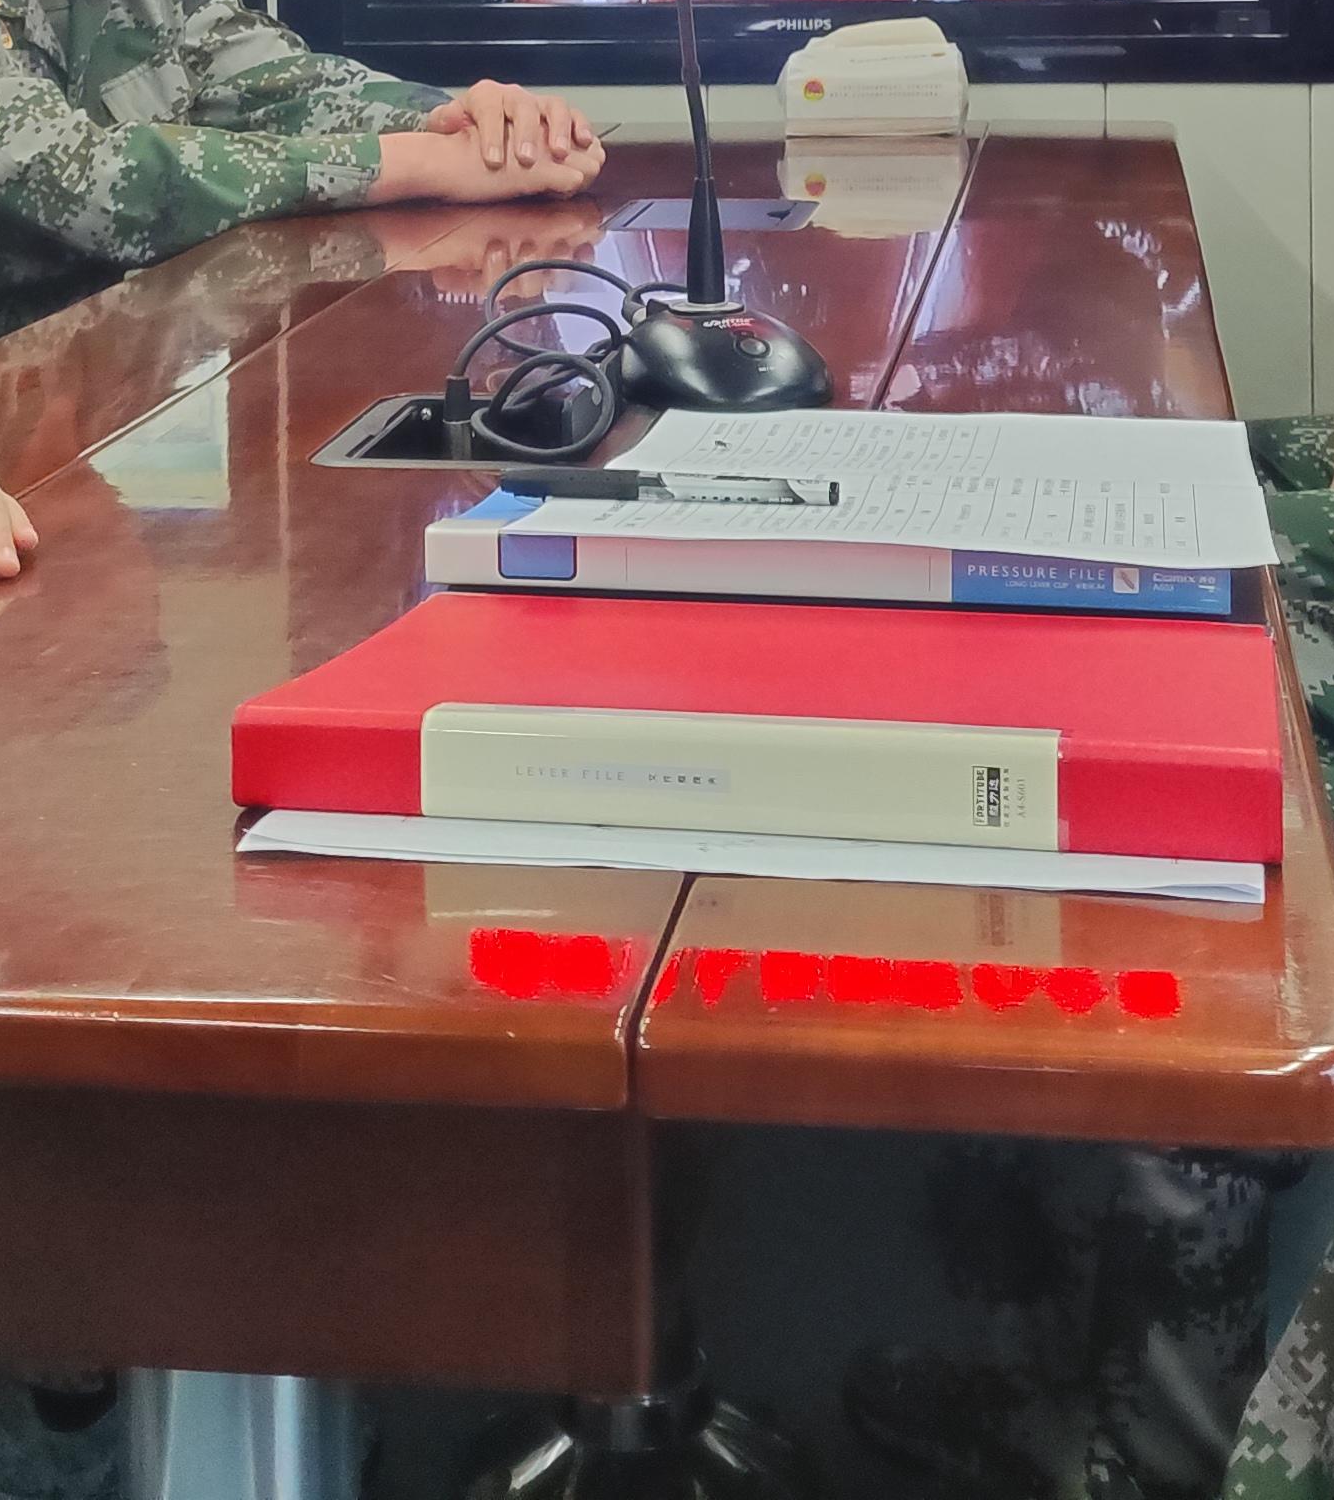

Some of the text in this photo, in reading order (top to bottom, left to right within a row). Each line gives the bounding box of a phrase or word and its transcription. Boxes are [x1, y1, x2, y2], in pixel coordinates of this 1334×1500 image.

[777, 18, 832, 31] PHILIPS
[967, 564, 1106, 581] PRESSURE FILE
[582, 768, 626, 782] FILE
